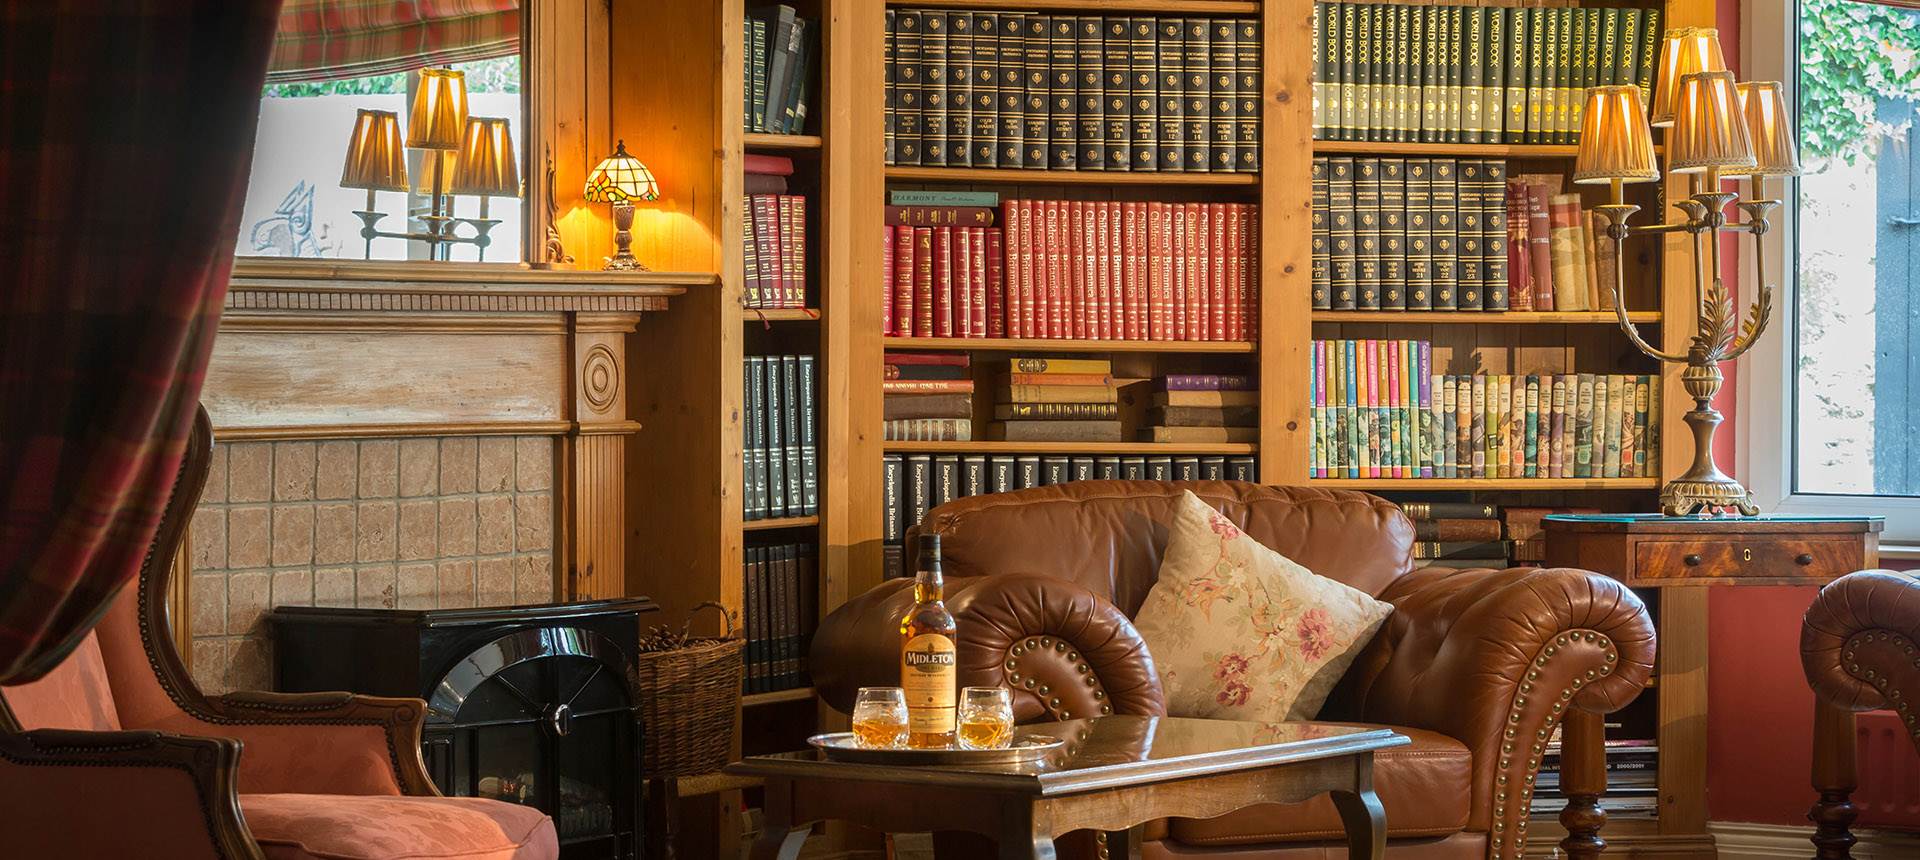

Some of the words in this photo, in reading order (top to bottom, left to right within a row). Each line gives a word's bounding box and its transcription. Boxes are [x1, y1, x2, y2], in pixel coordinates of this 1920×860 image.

[1328, 6, 1336, 38] WORLD
[1345, 7, 1353, 38] WORLD
[1360, 8, 1368, 39] WORLD
[1374, 8, 1382, 38] WORLD
[1386, 8, 1394, 38] WORLD
[1399, 8, 1407, 39] WORLD
[1412, 9, 1421, 41] WORLD
[1440, 9, 1448, 41] WORLD
[1452, 10, 1460, 41] WORLD
[1471, 10, 1479, 41] WORLD
[1491, 11, 1500, 42] WORLD
[1534, 12, 1542, 42] WORLD
[1547, 12, 1556, 42] WORLD
[1561, 12, 1569, 42] WORLD
[1574, 12, 1583, 42] WORLD
[1588, 12, 1598, 42] WORLD
[1606, 13, 1615, 43] WORLD
[1625, 13, 1634, 43] WORLD
[1647, 14, 1657, 43] WORLD
[1328, 38, 1336, 62] BOOK
[1345, 39, 1353, 63] BOOK
[1359, 39, 1367, 64] BOOK
[1439, 41, 1447, 65] BOOK
[1547, 43, 1555, 68] BOOK
[1560, 44, 1568, 68] BOOK
[1604, 44, 1613, 68] BOOK
[1623, 44, 1631, 68] BOOK
[1644, 45, 1653, 68] BOOK
[1008, 208, 1017, 252] Children's
[1021, 209, 1029, 251] Children's
[1034, 209, 1042, 251] Children's
[1048, 210, 1056, 252] Children's
[1073, 210, 1082, 252] Children's
[1086, 211, 1094, 252] Children's
[1098, 211, 1107, 252] Children's
[1112, 210, 1121, 252] Children's
[1126, 211, 1134, 252] Children's
[1137, 211, 1145, 253] Children's
[1151, 211, 1159, 253] Children's
[1175, 212, 1184, 254] Children's
[1188, 212, 1196, 253] Children's
[1200, 212, 1208, 254] Children's
[1009, 254, 1017, 296] Britannica
[1049, 254, 1058, 296] Britannica
[1100, 255, 1108, 298] Britannica
[1163, 256, 1172, 298] Britannica
[907, 652, 953, 664] MIDLETON
